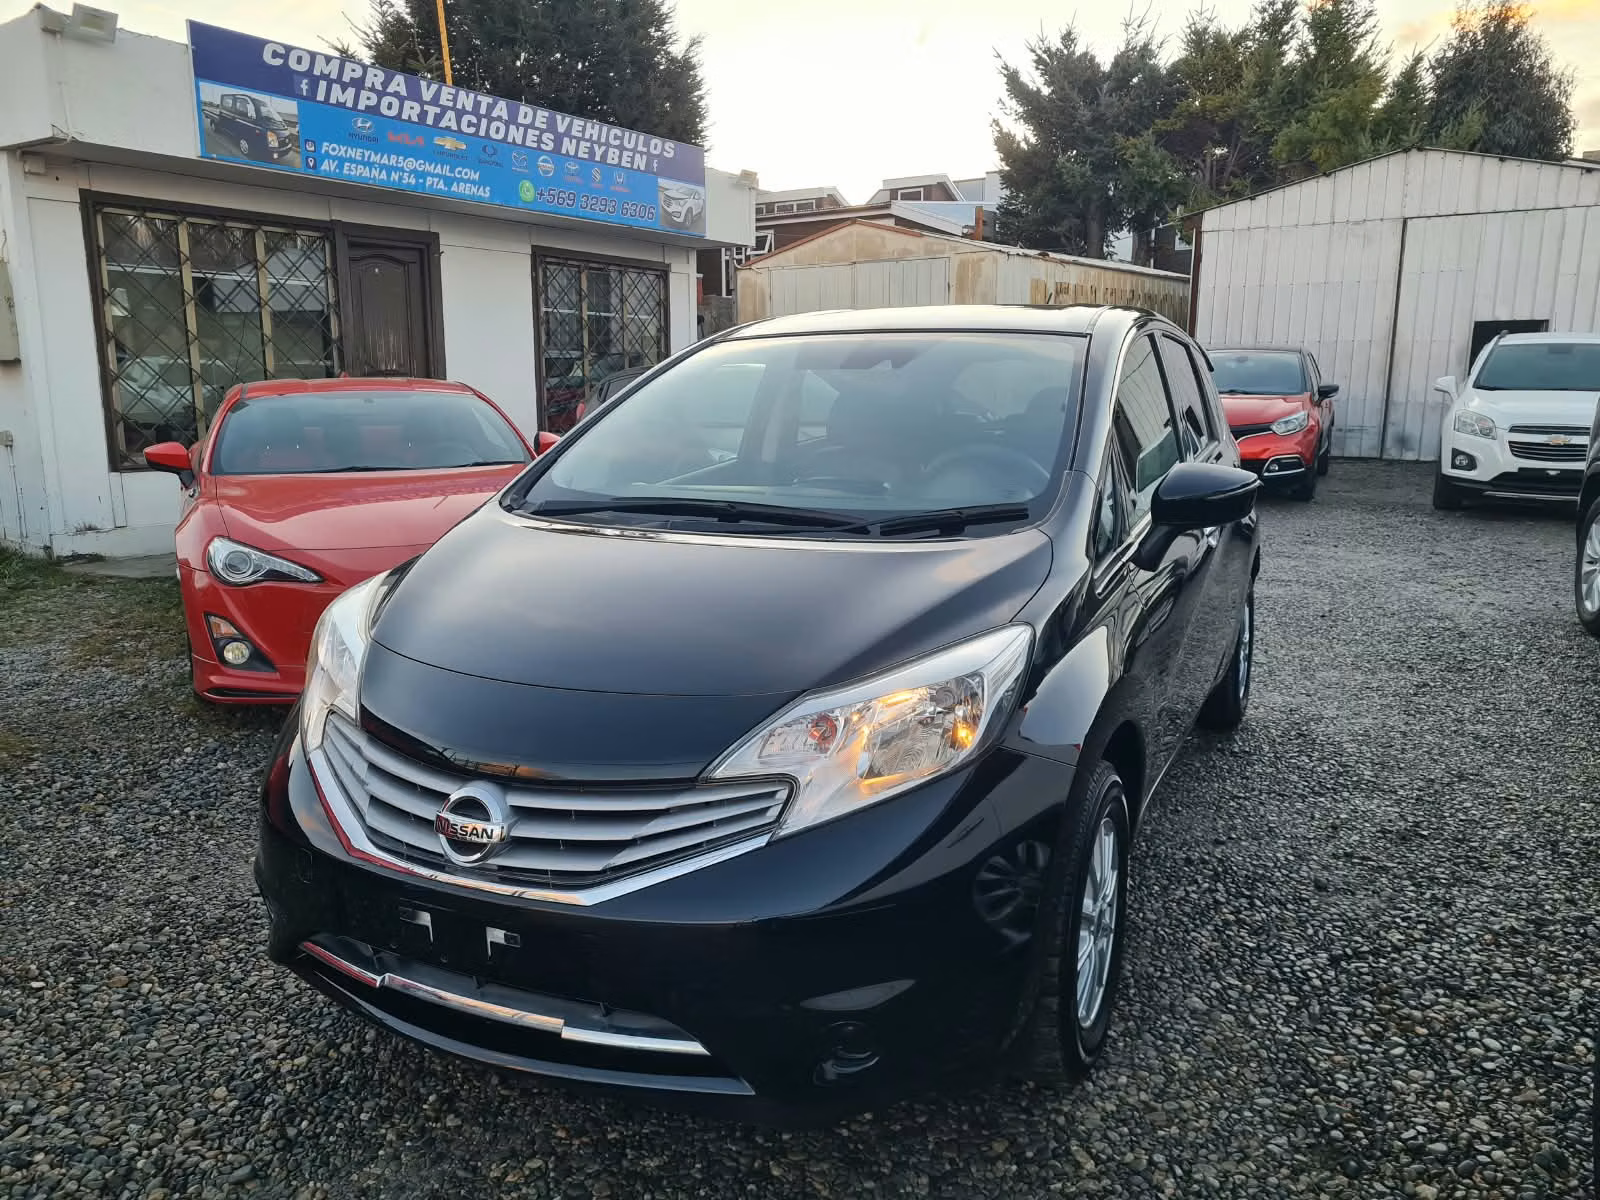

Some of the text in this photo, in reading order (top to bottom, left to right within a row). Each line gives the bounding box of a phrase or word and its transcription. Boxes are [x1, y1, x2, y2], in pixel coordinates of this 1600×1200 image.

[262, 42, 675, 158] COMPRA VENTA DE VEHICULOS
[316, 82, 647, 170] IMPORTACIONES NEYBEN
[320, 159, 339, 173] AV.
[343, 162, 387, 181] ESPAÑA
[426, 177, 448, 191] PTA.
[451, 182, 491, 198] ARENAS
[321, 142, 480, 182] FOXNEYMAR5@GMAIL.COM
[536, 188, 657, 223] +569 3293 6306
[436, 815, 494, 840] NISSAN
